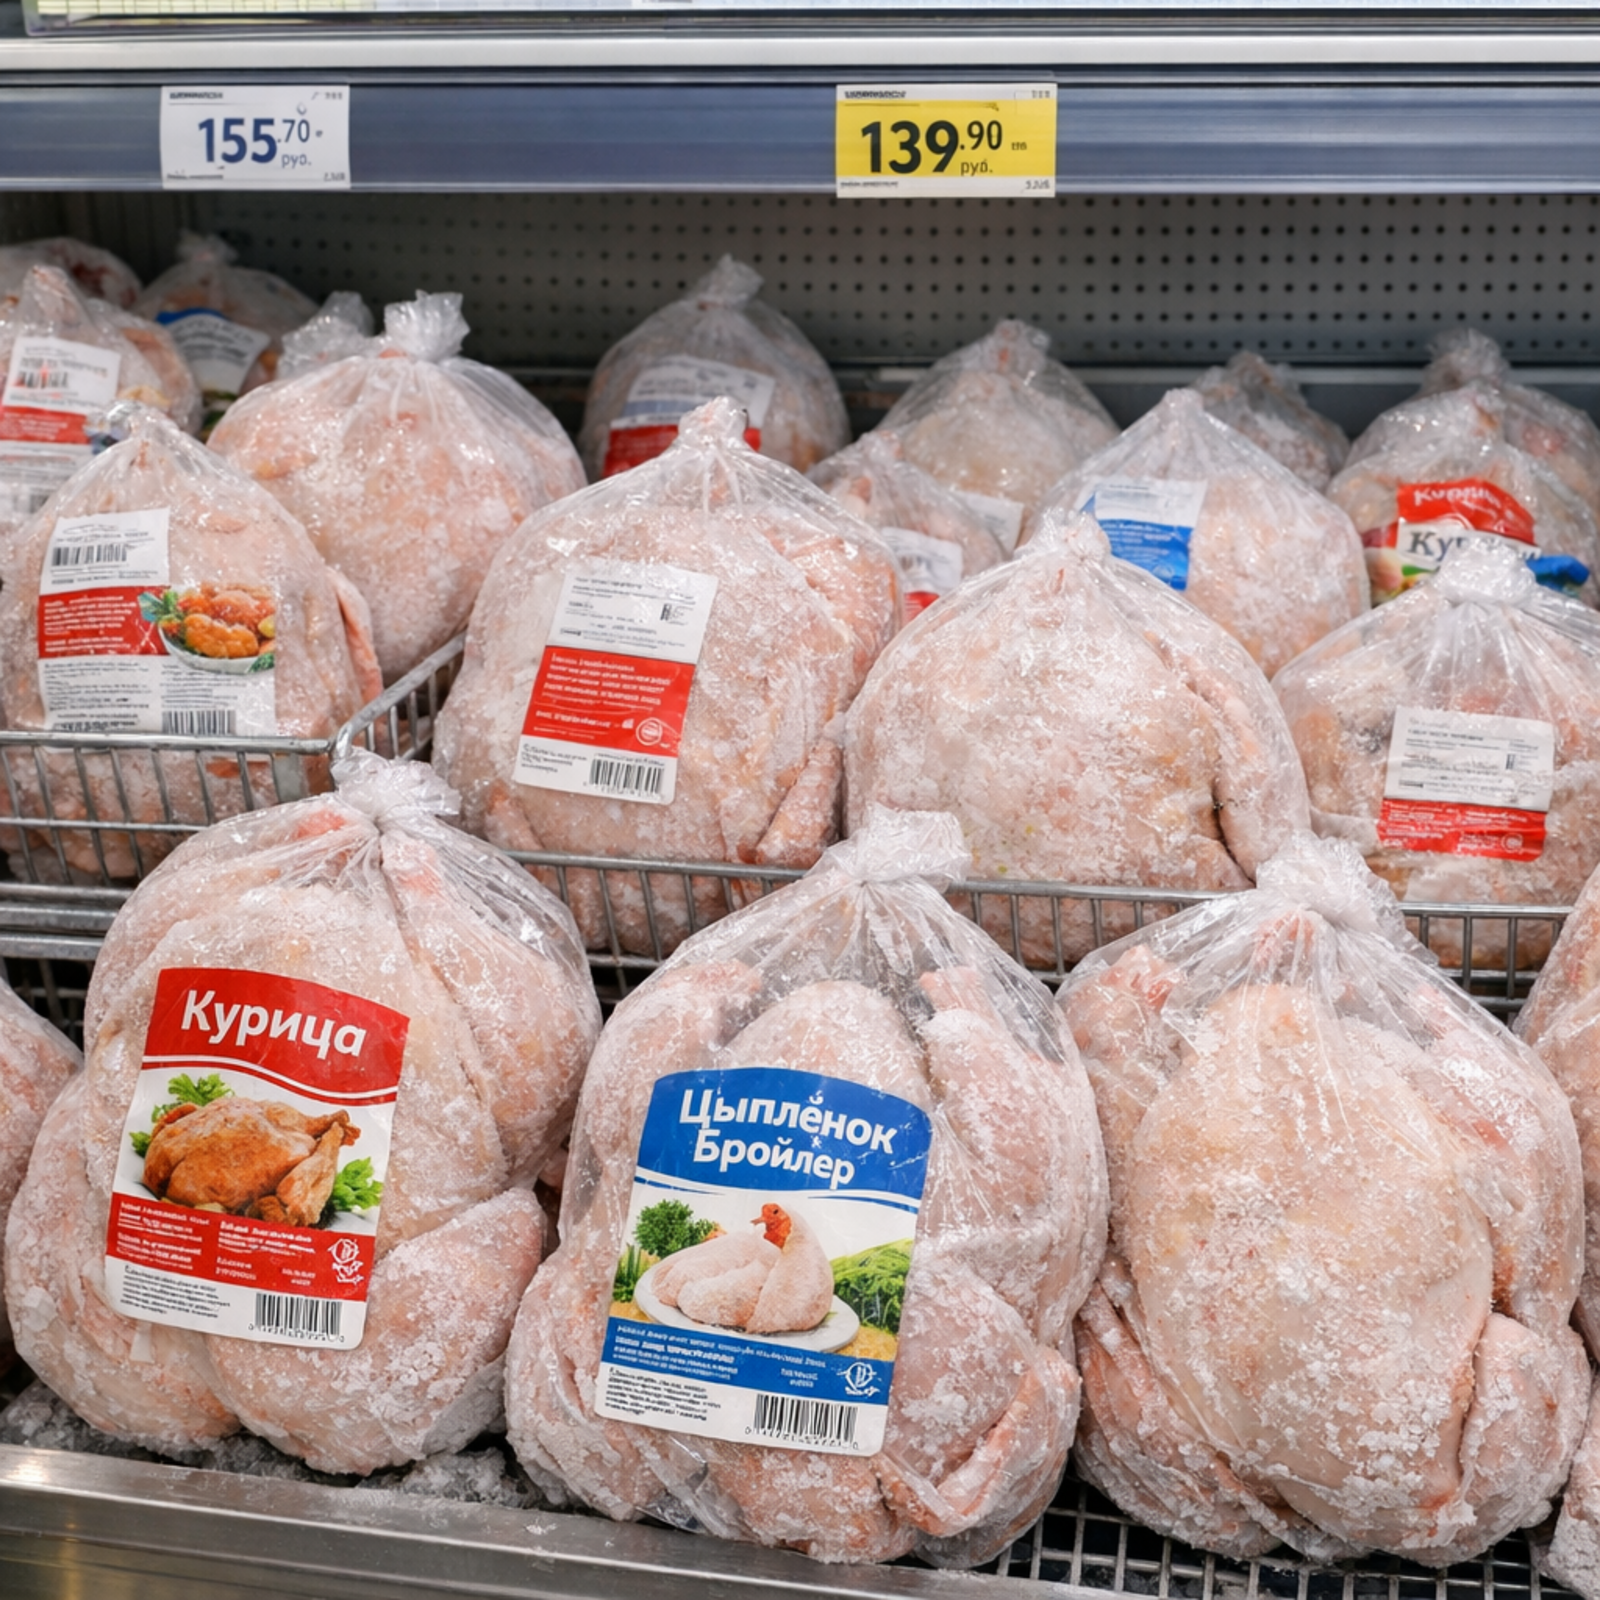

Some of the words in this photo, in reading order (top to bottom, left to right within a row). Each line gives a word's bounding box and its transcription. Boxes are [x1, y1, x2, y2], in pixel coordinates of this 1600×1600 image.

[181, 989, 367, 1060] Курица
[679, 1088, 898, 1154] Цыплёнок
[693, 1128, 855, 1190] Бройлер
